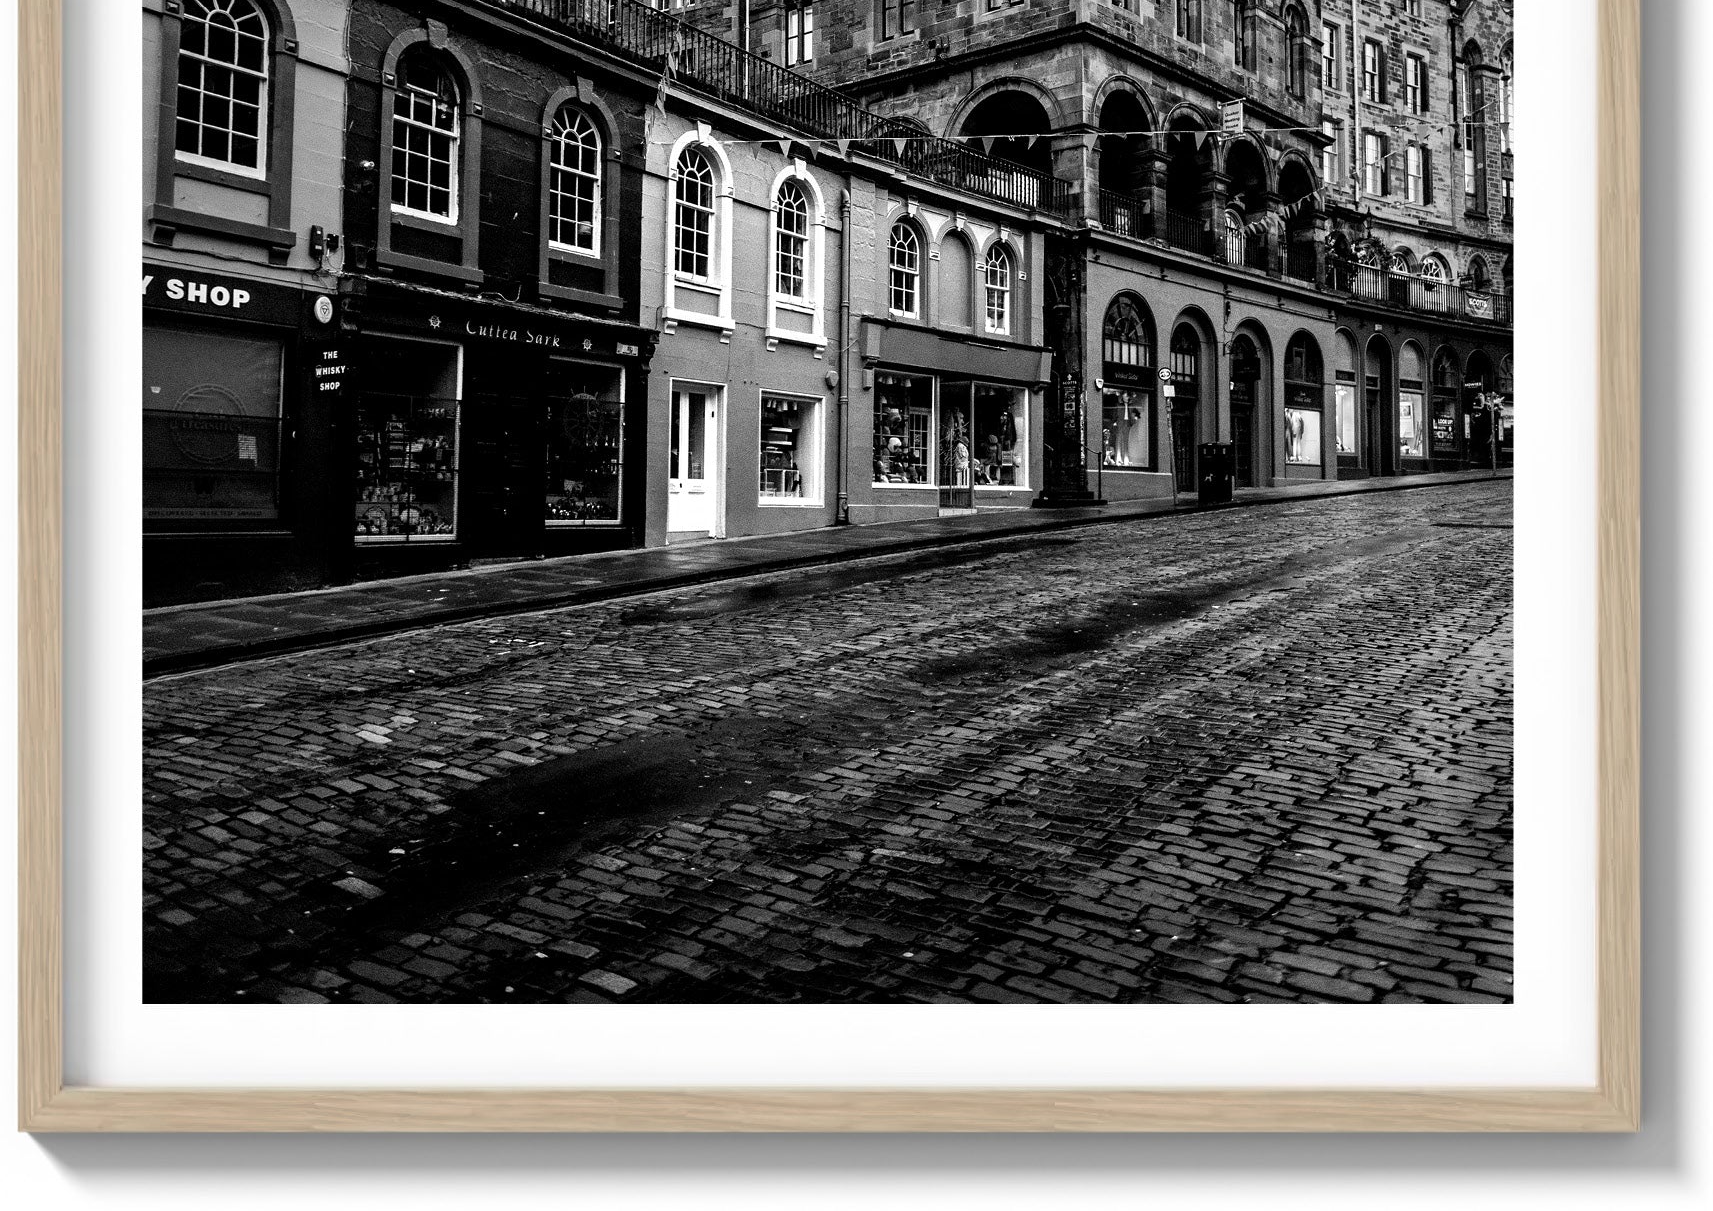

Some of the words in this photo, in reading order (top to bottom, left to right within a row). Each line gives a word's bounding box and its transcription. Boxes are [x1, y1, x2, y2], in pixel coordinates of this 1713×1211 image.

[166, 278, 250, 308] SHOP
[465, 320, 517, 341] Cuttea
[526, 329, 560, 347] Sark
[322, 350, 338, 360] THE
[315, 365, 346, 377] WHISKY
[319, 381, 341, 391] SHOP
